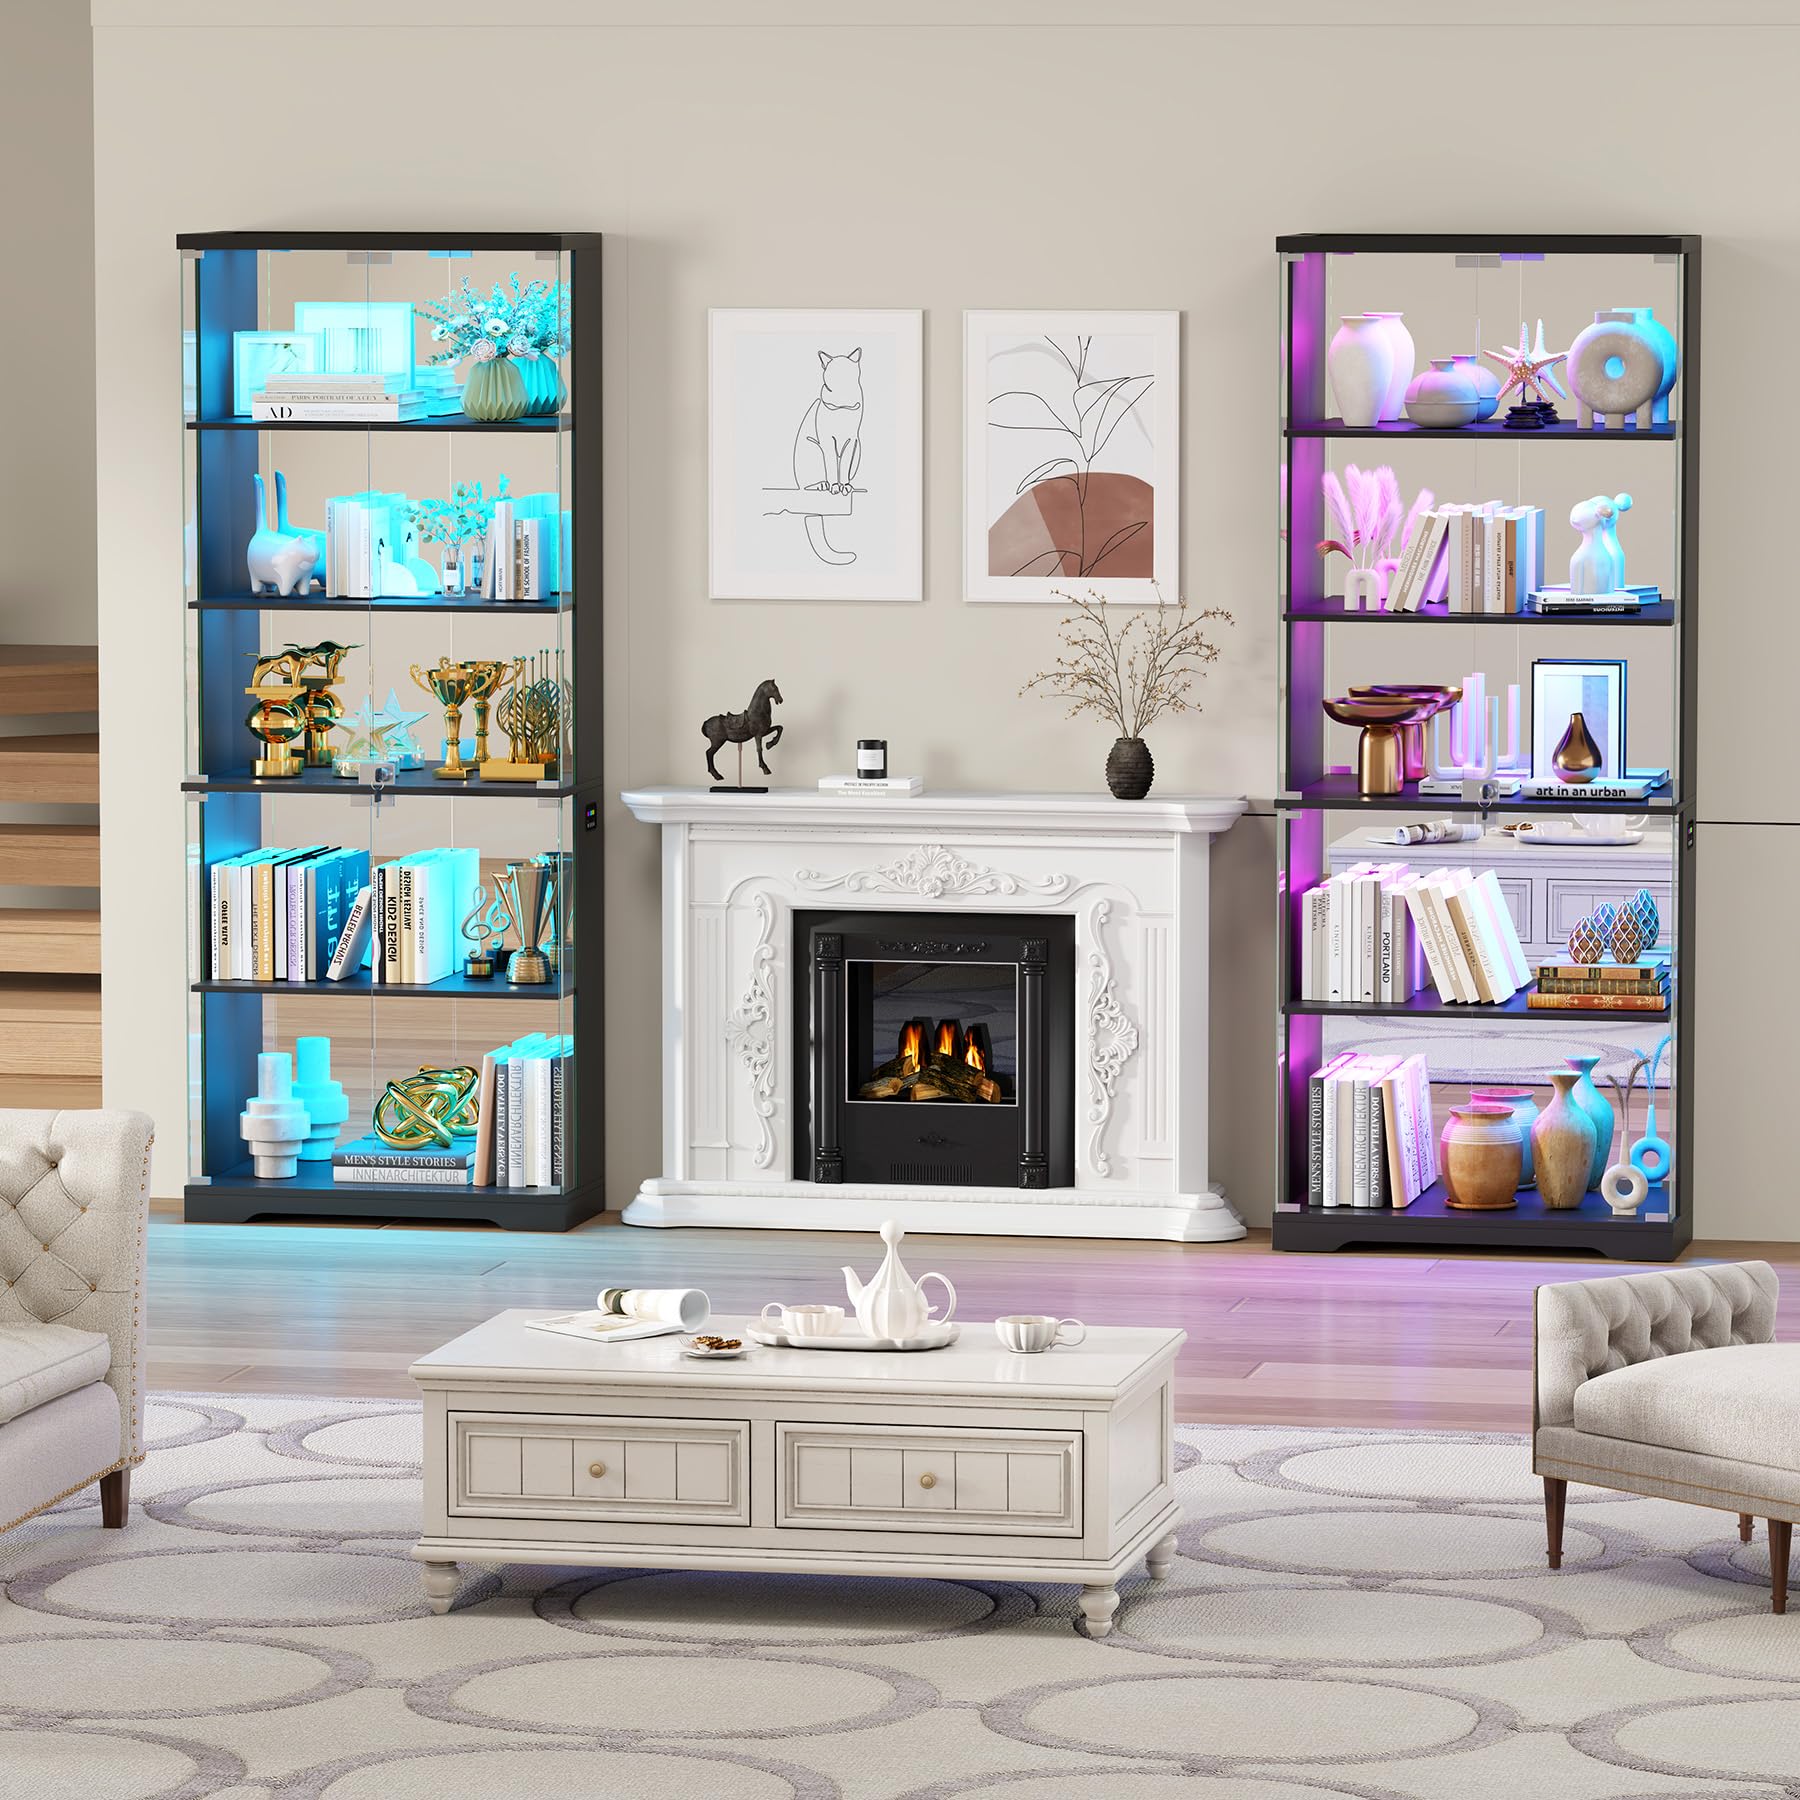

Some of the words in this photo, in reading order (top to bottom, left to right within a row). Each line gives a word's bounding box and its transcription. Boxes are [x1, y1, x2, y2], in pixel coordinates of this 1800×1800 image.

[1536, 785, 1554, 797] art
[1556, 785, 1569, 797] in
[1572, 788, 1587, 797] an
[1590, 786, 1627, 798] urban
[1382, 932, 1391, 984] PORTLAND
[1311, 1086, 1322, 1129] STORIES
[1371, 1096, 1380, 1153] DONATELLA
[1311, 1129, 1322, 1161] STYLE
[1354, 1087, 1367, 1189] INNENARCHITEKTUR
[344, 1154, 376, 1166] MEN'S
[377, 1155, 411, 1166] STYLE
[412, 1156, 456, 1167] STORIES
[352, 1168, 460, 1183] INNENARCHITEKTUR
[1371, 1154, 1380, 1198] VERSACE
